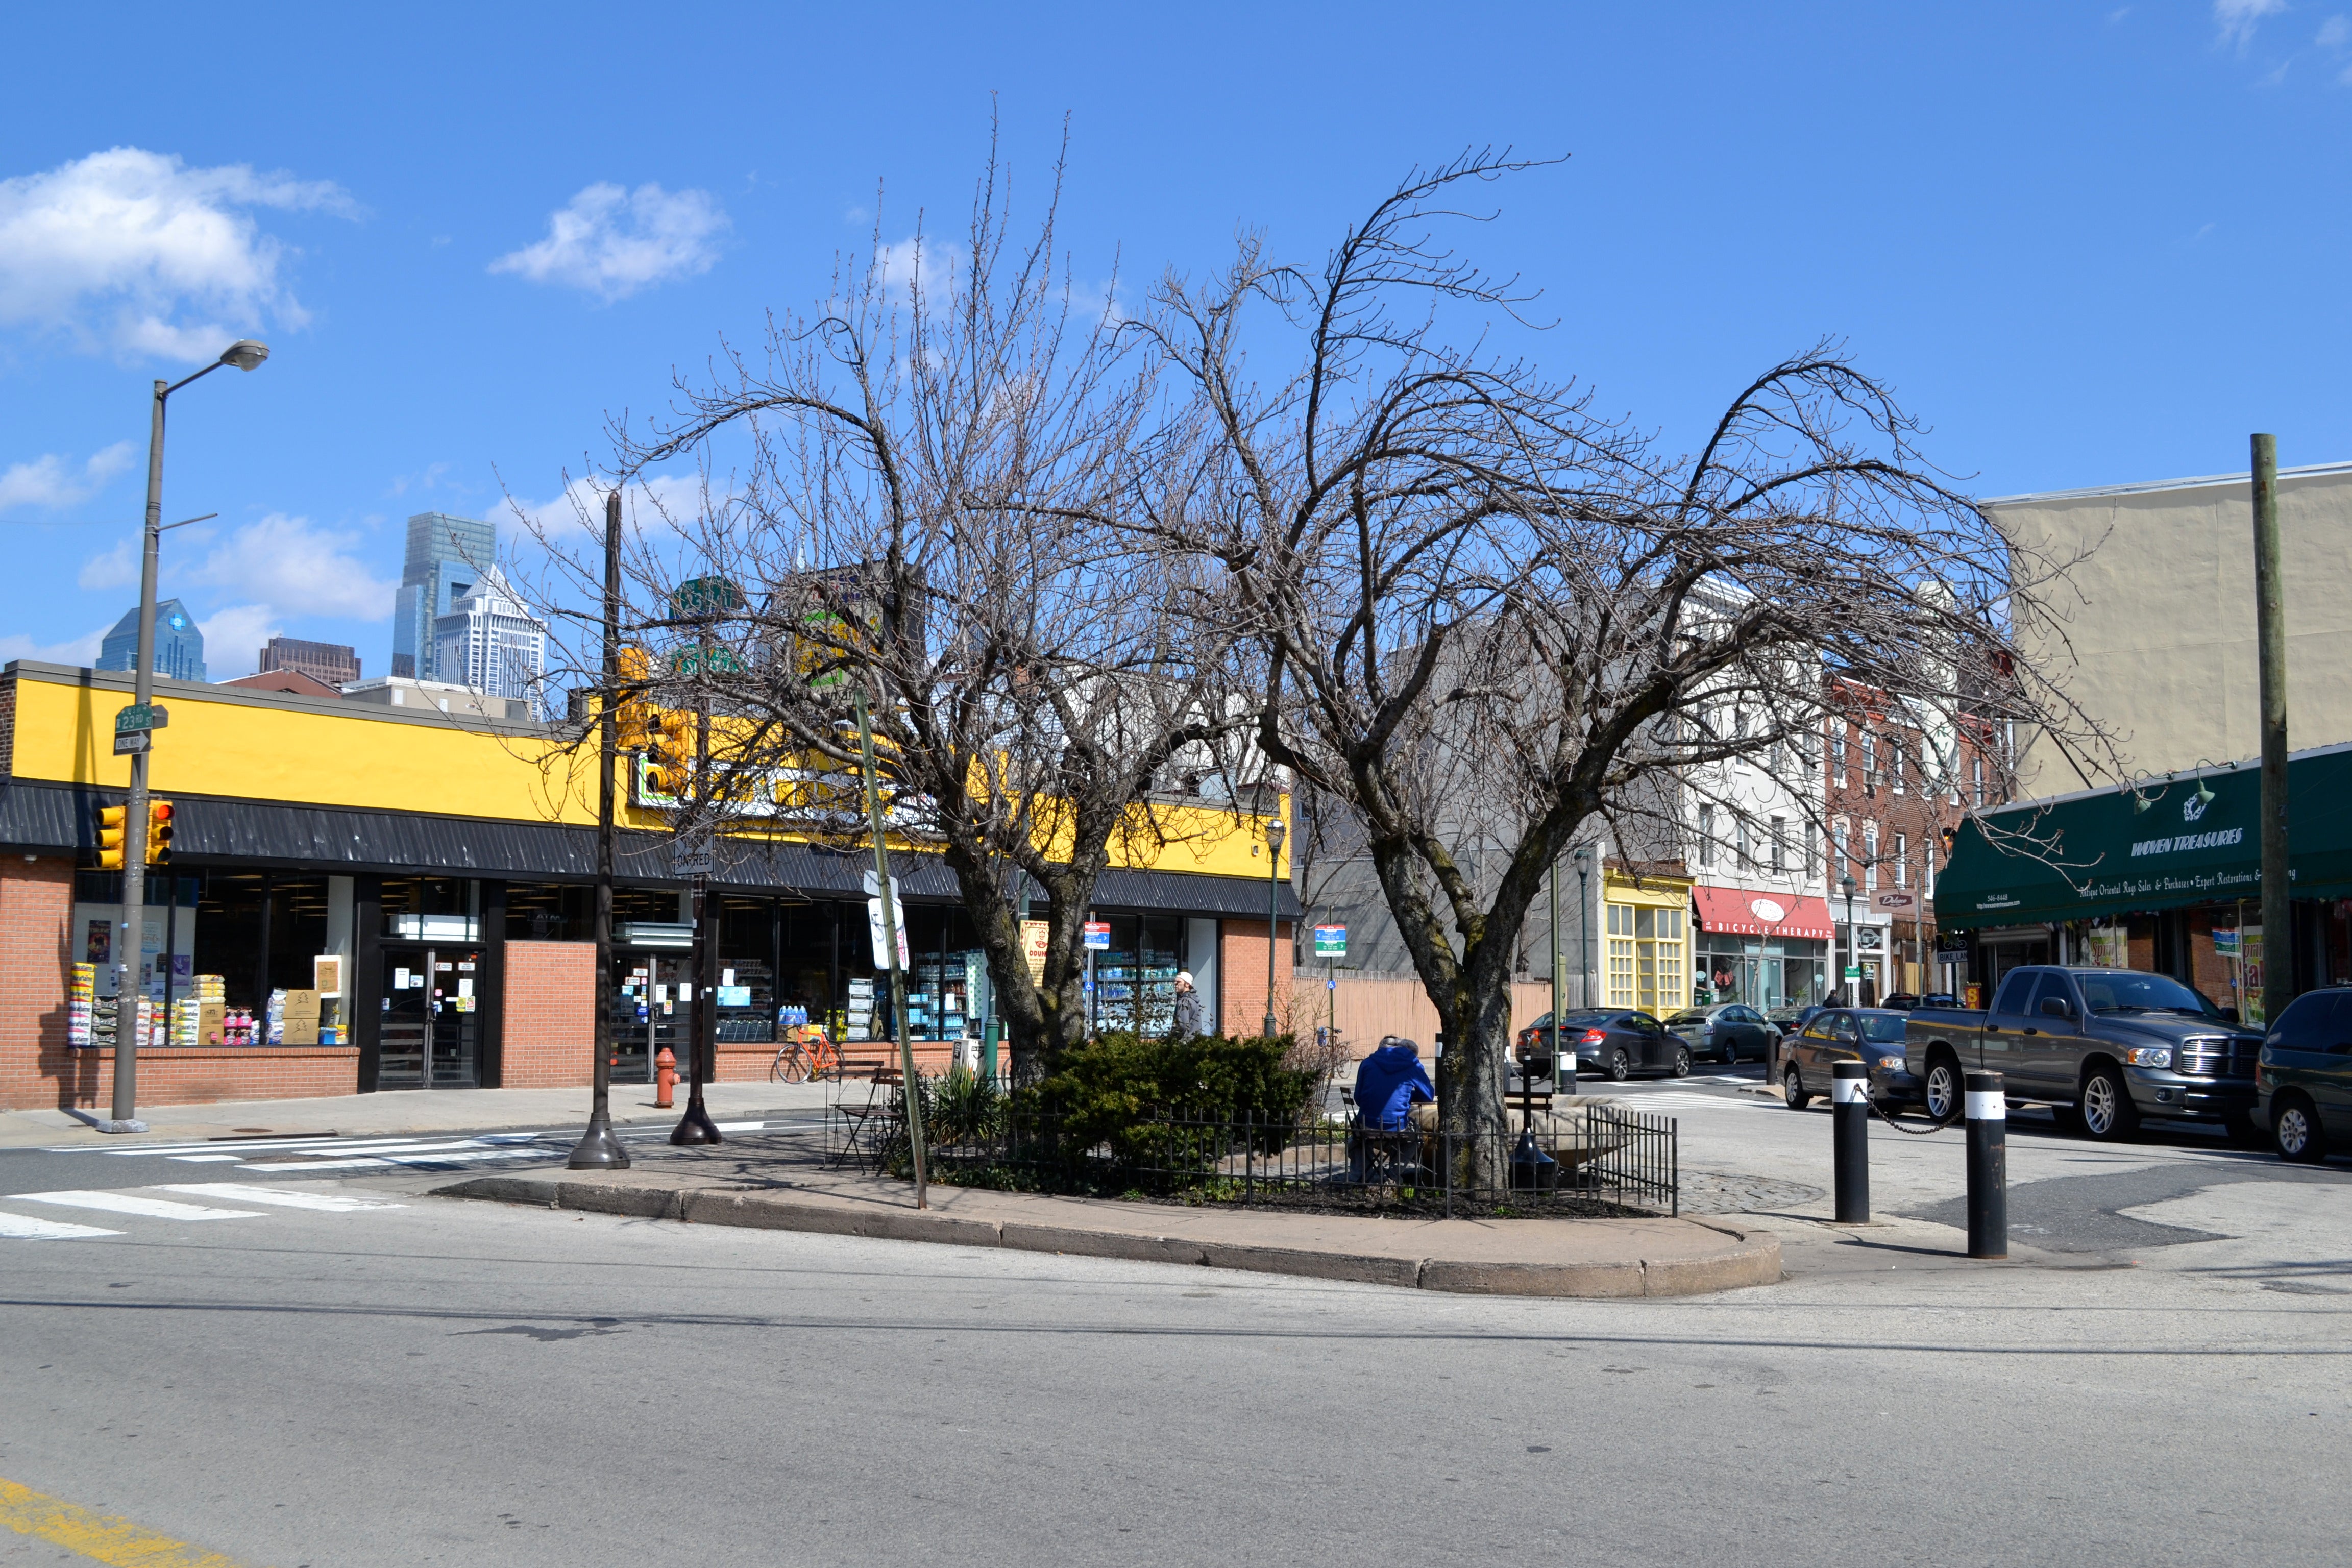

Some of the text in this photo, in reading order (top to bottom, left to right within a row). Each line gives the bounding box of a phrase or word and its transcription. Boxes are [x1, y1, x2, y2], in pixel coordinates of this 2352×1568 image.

[118, 737, 141, 748] ONE WAY
[2131, 827, 2243, 856] WOVEN TREASURES
[677, 853, 710, 867] ON RED
[2080, 869, 2262, 900] Antique Oriental Rugs Sales & Purchases Expert Restorations &
[1882, 896, 1907, 904] Deluxe
[1776, 926, 1823, 938] THERAPY
[1940, 952, 1969, 961] BIKE LAN
[2239, 940, 2263, 961] prin
[2239, 960, 2265, 988] Sal
